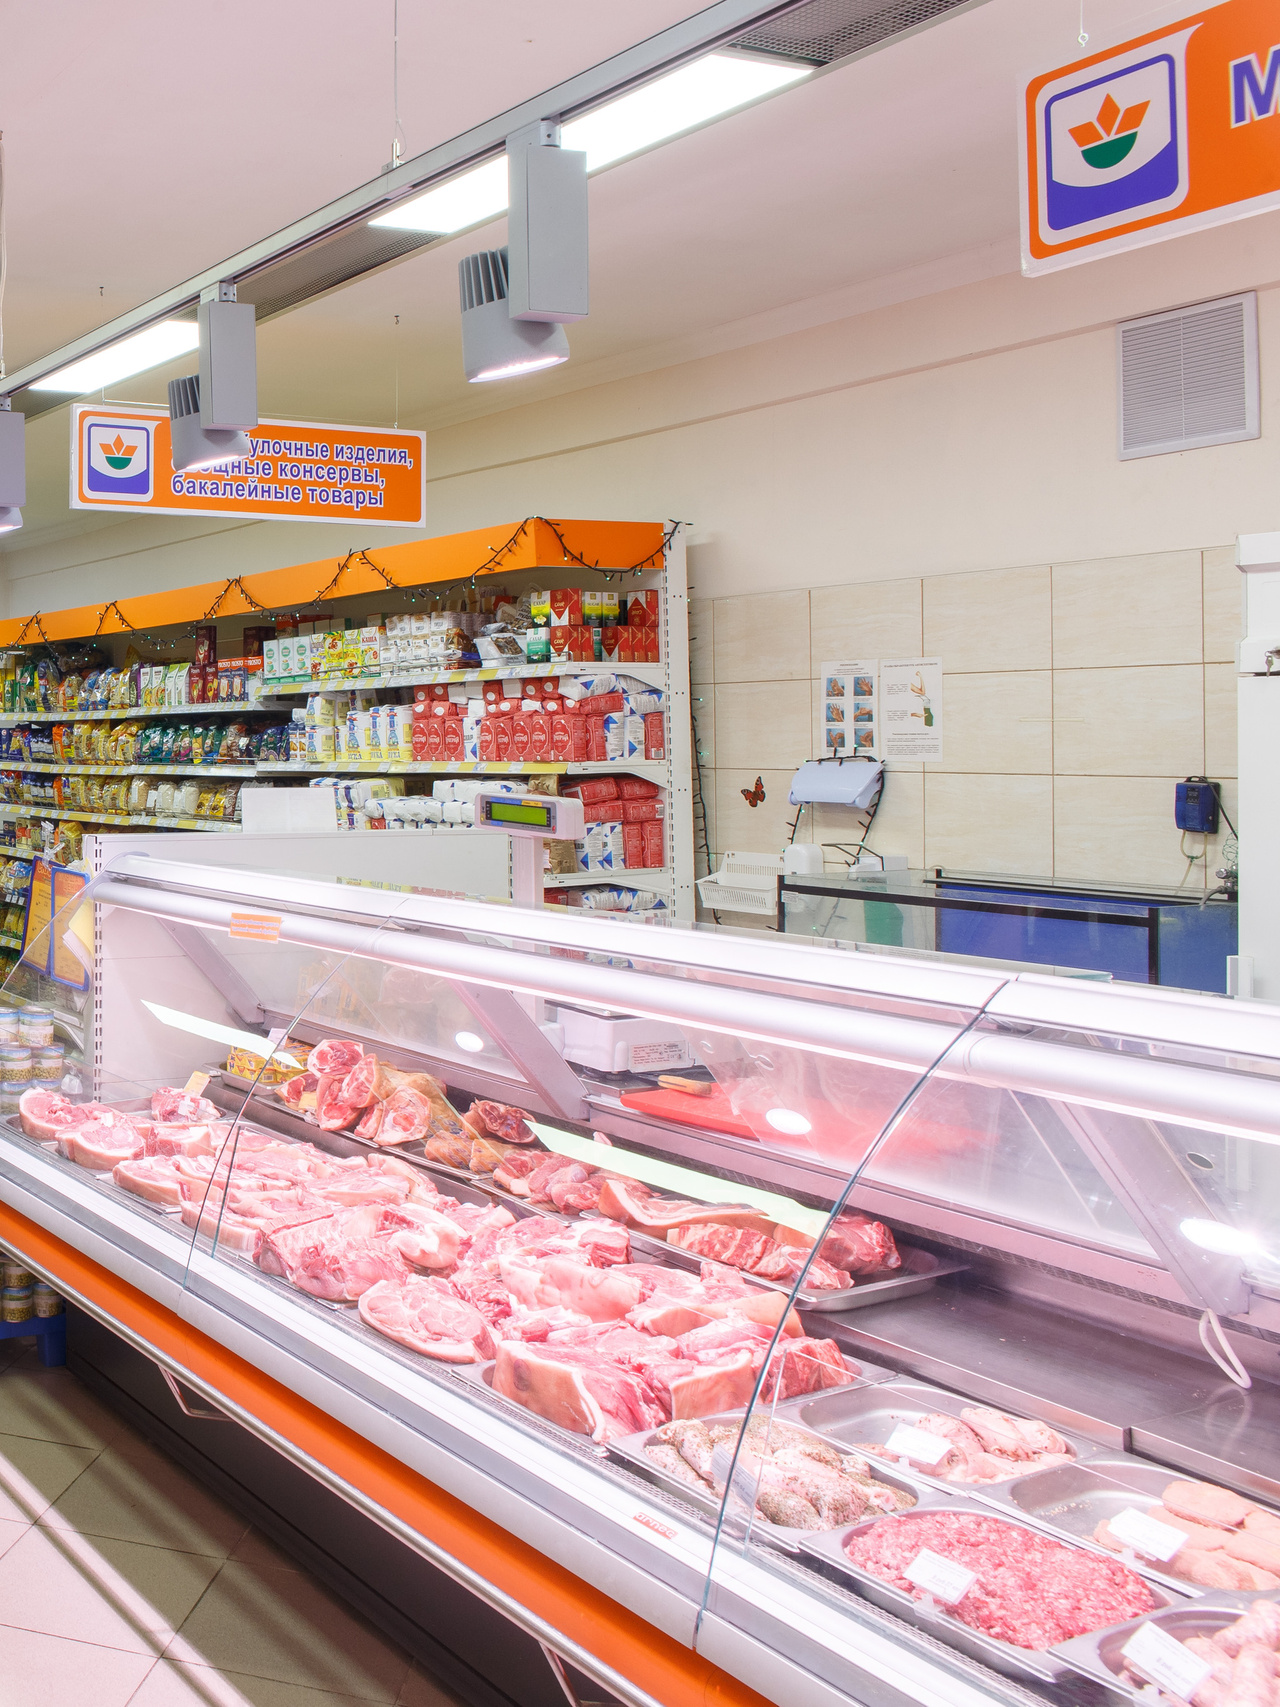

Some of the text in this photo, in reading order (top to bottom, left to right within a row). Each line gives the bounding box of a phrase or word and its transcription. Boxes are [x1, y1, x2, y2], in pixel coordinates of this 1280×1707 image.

[335, 445, 413, 469] изделия,
[279, 463, 386, 489] консервы,
[172, 474, 384, 511] бакалейные товары
